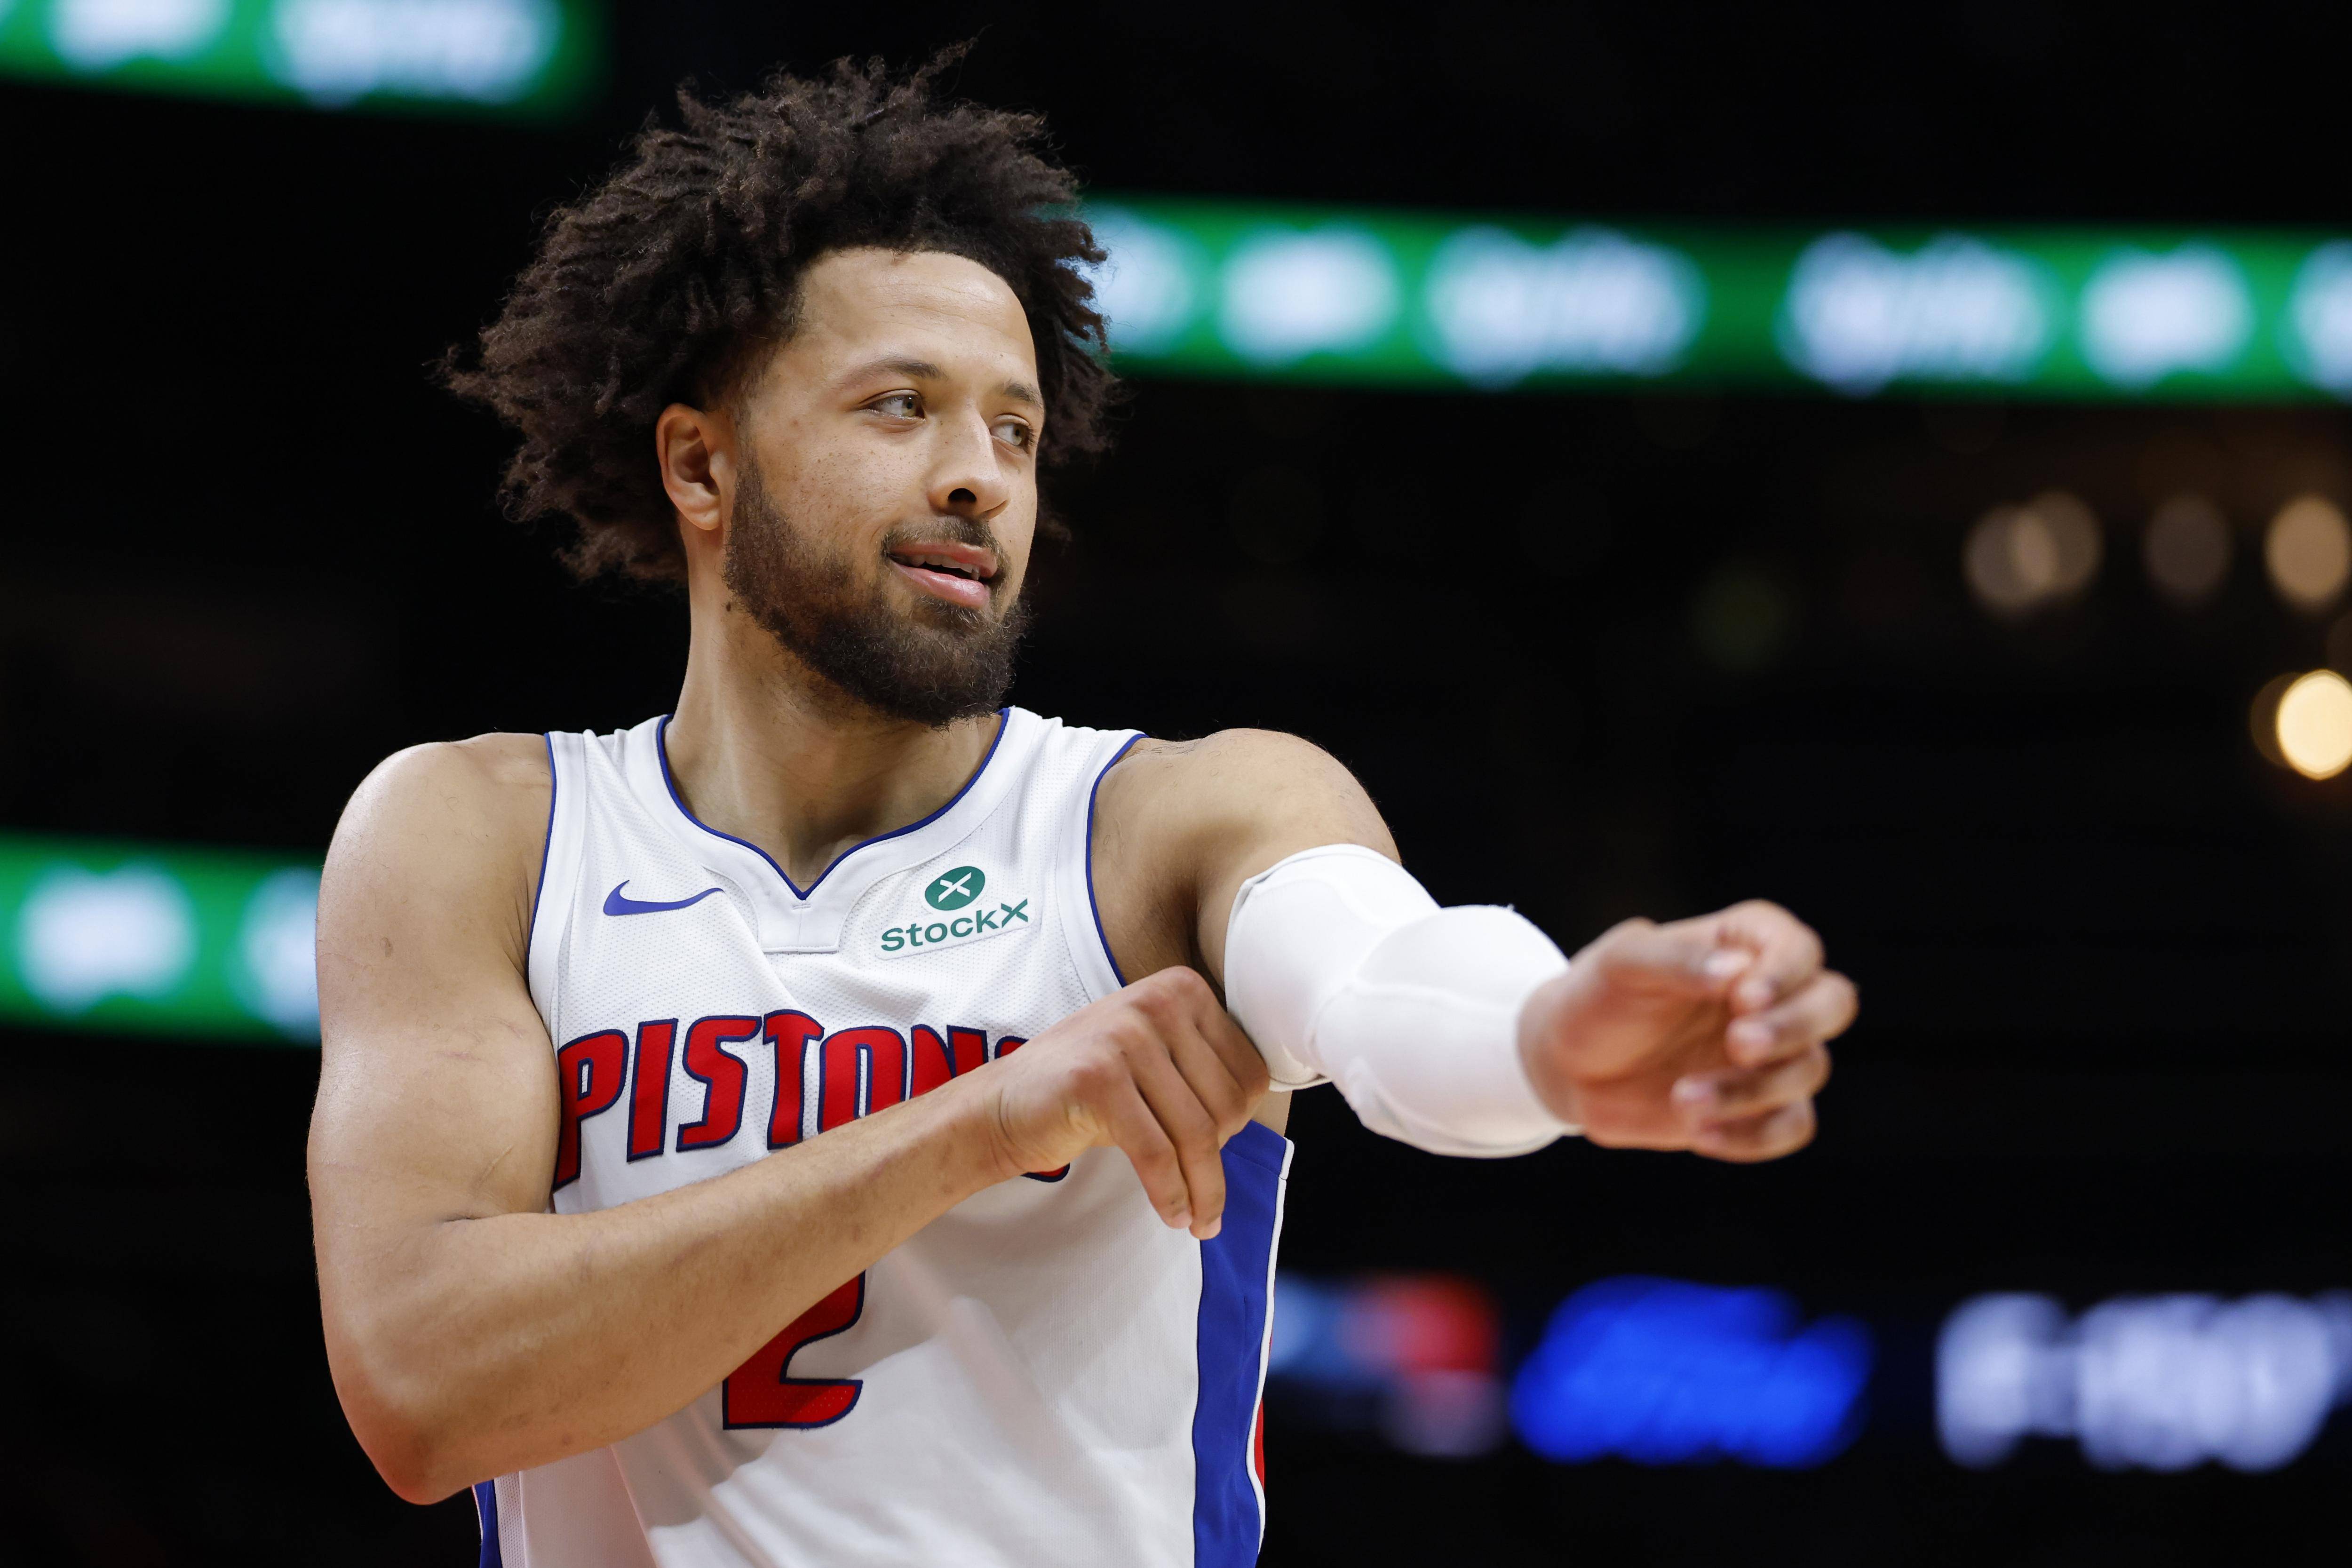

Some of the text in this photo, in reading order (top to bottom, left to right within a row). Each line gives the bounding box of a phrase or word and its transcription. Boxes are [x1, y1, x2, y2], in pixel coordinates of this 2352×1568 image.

[881, 898, 1028, 951] StockX
[553, 1009, 1070, 1193] PISTON
[723, 1270, 864, 1430] 2
